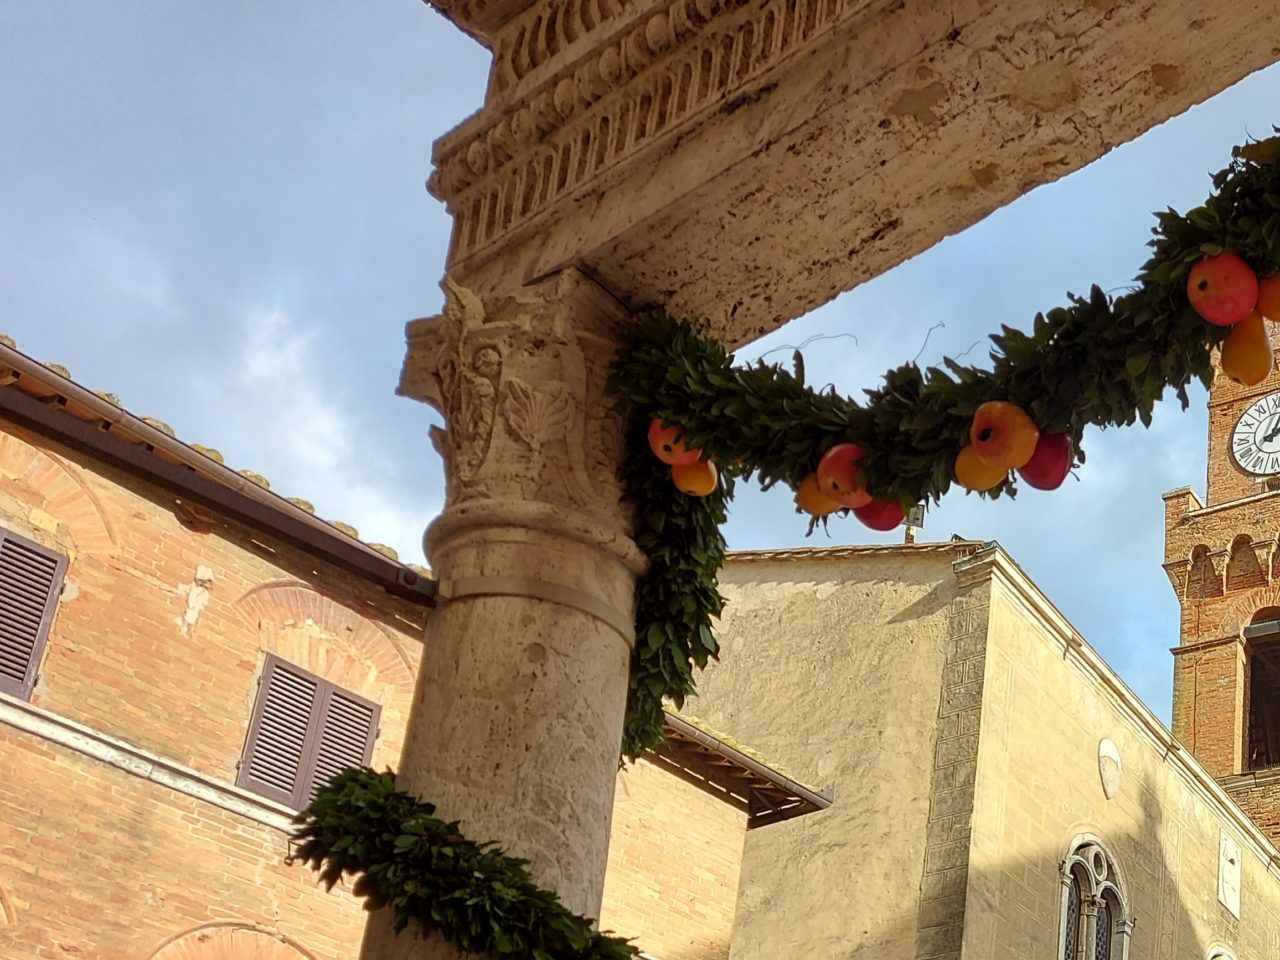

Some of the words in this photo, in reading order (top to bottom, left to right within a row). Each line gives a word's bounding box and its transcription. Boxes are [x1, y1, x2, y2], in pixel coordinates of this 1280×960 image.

[1254, 404, 1267, 418] XI
[1242, 420, 1255, 430] X
[1236, 435, 1250, 446] IX
[1239, 447, 1254, 463] VIII
[1252, 456, 1265, 470] VII
[1271, 457, 1280, 469] VI
